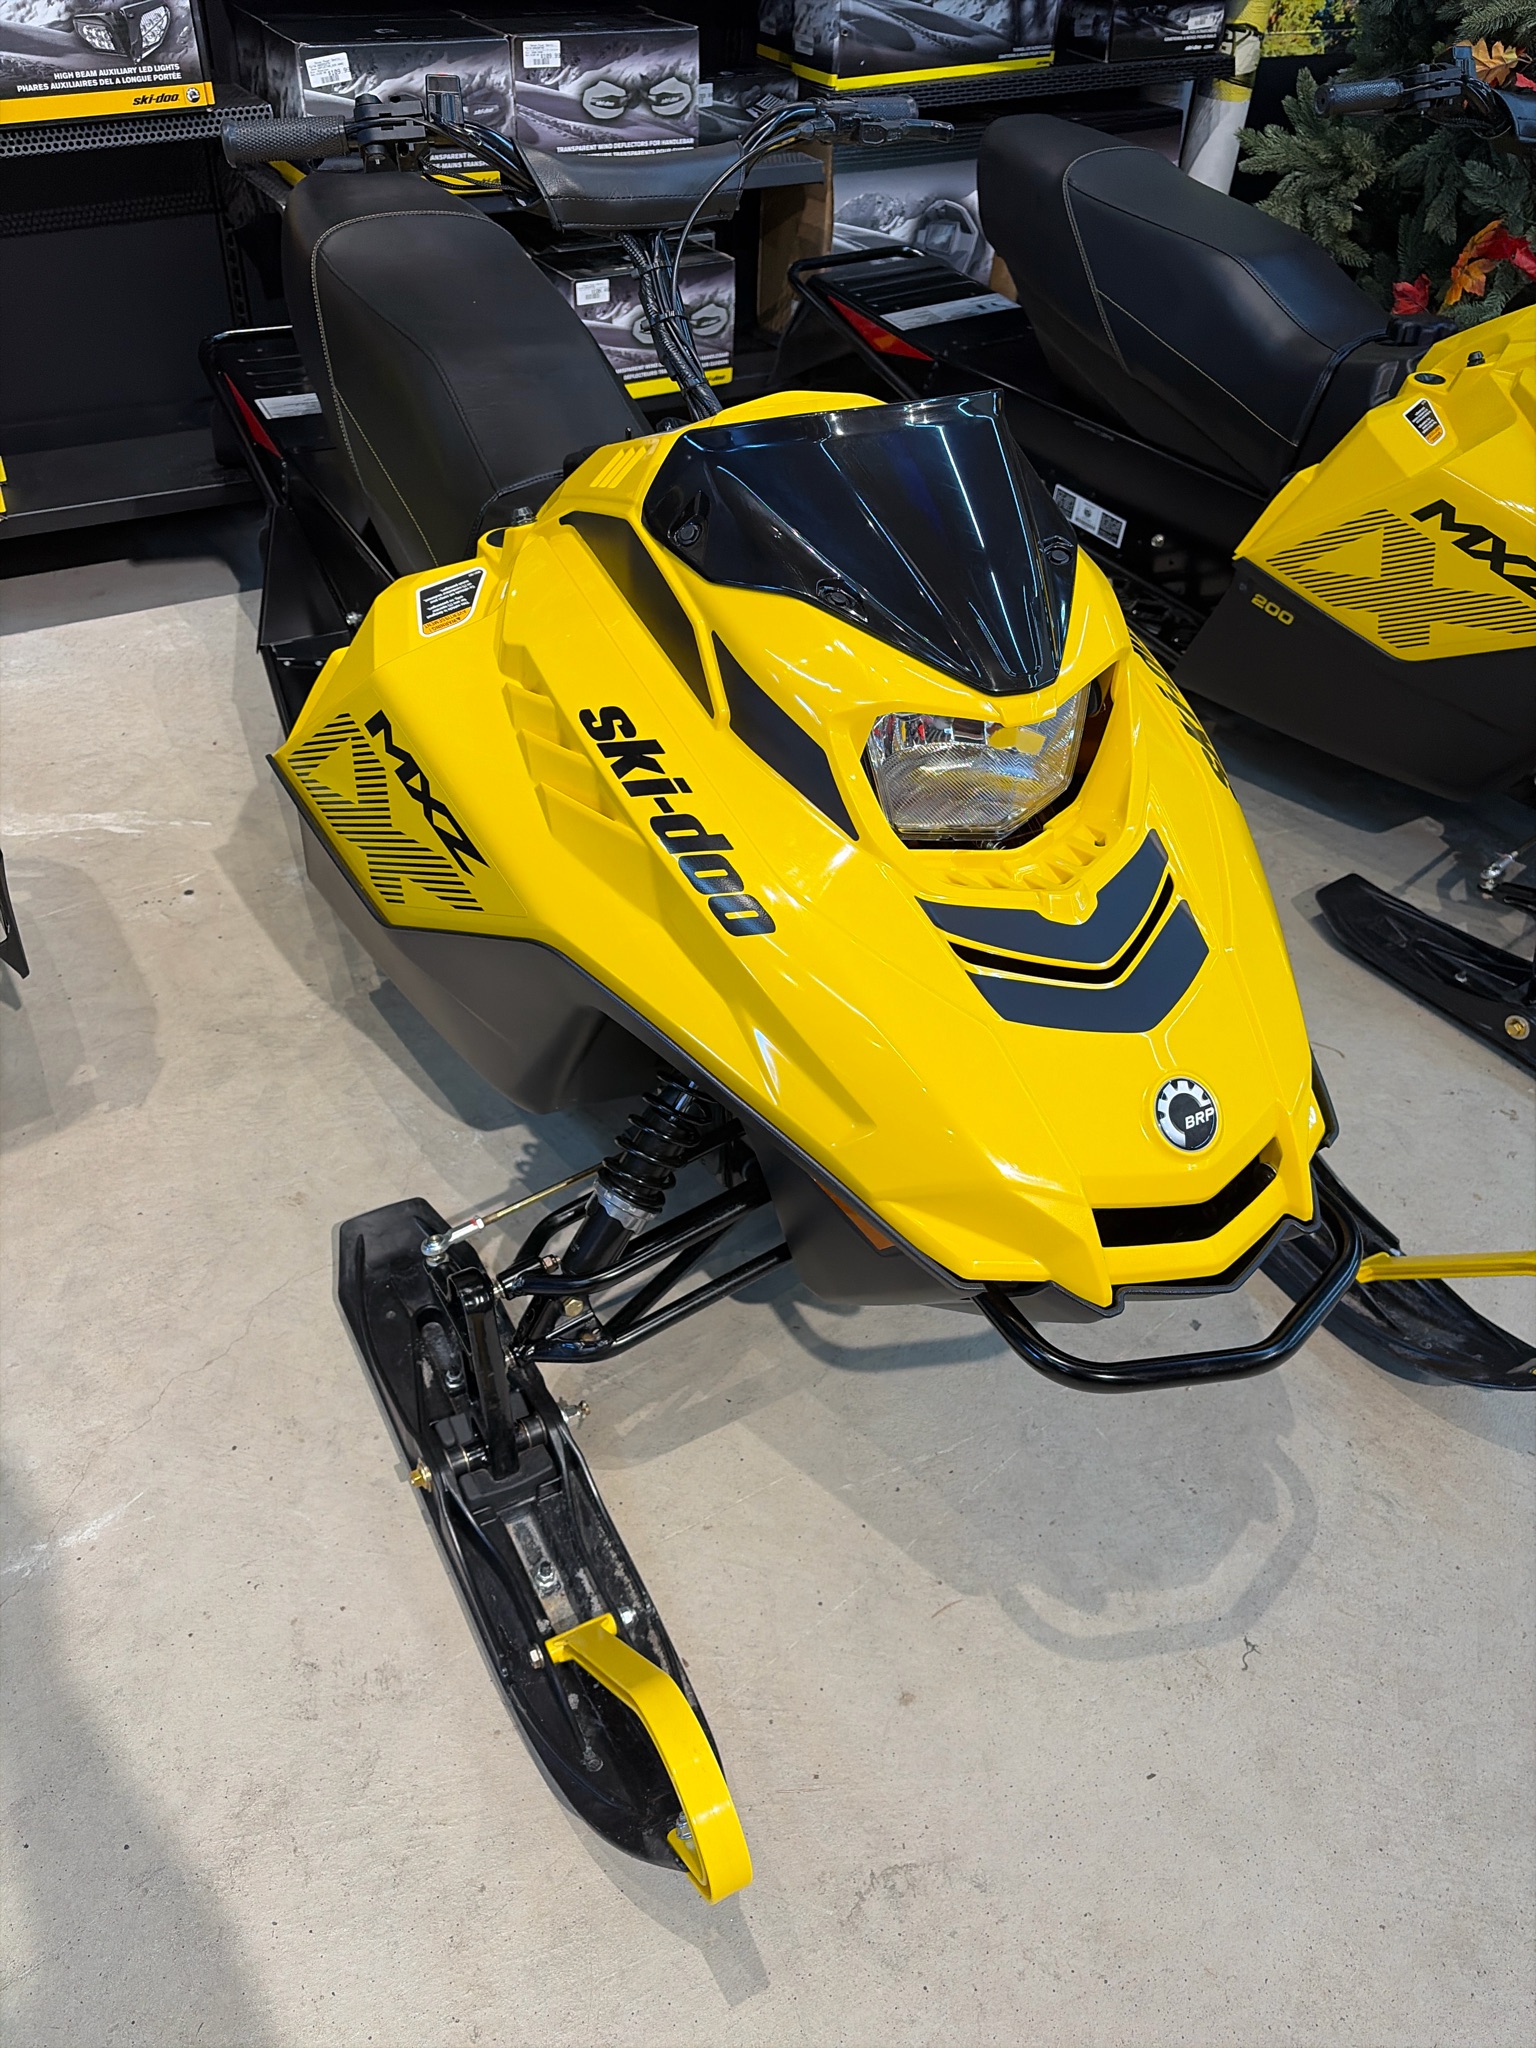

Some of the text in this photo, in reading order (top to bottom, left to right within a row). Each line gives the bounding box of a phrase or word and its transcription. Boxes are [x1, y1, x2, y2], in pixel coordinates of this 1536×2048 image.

[54, 63, 180, 80] HIGH BEAM AUXILIARY LED LIGHTS
[17, 83, 49, 92] PHARES
[50, 79, 98, 90] AUXILIAIRES
[100, 78, 114, 86] DEL
[122, 75, 152, 84] LONGUE
[153, 72, 182, 81] PORTÉE
[132, 93, 179, 105] ski-doo
[613, 141, 648, 149] DEFLECTORS
[430, 153, 466, 161] ANSPARENT
[1251, 594, 1294, 626] 200
[364, 709, 491, 877] MXZ
[579, 706, 776, 936] ski-doo
[1185, 1107, 1214, 1129] BRP
